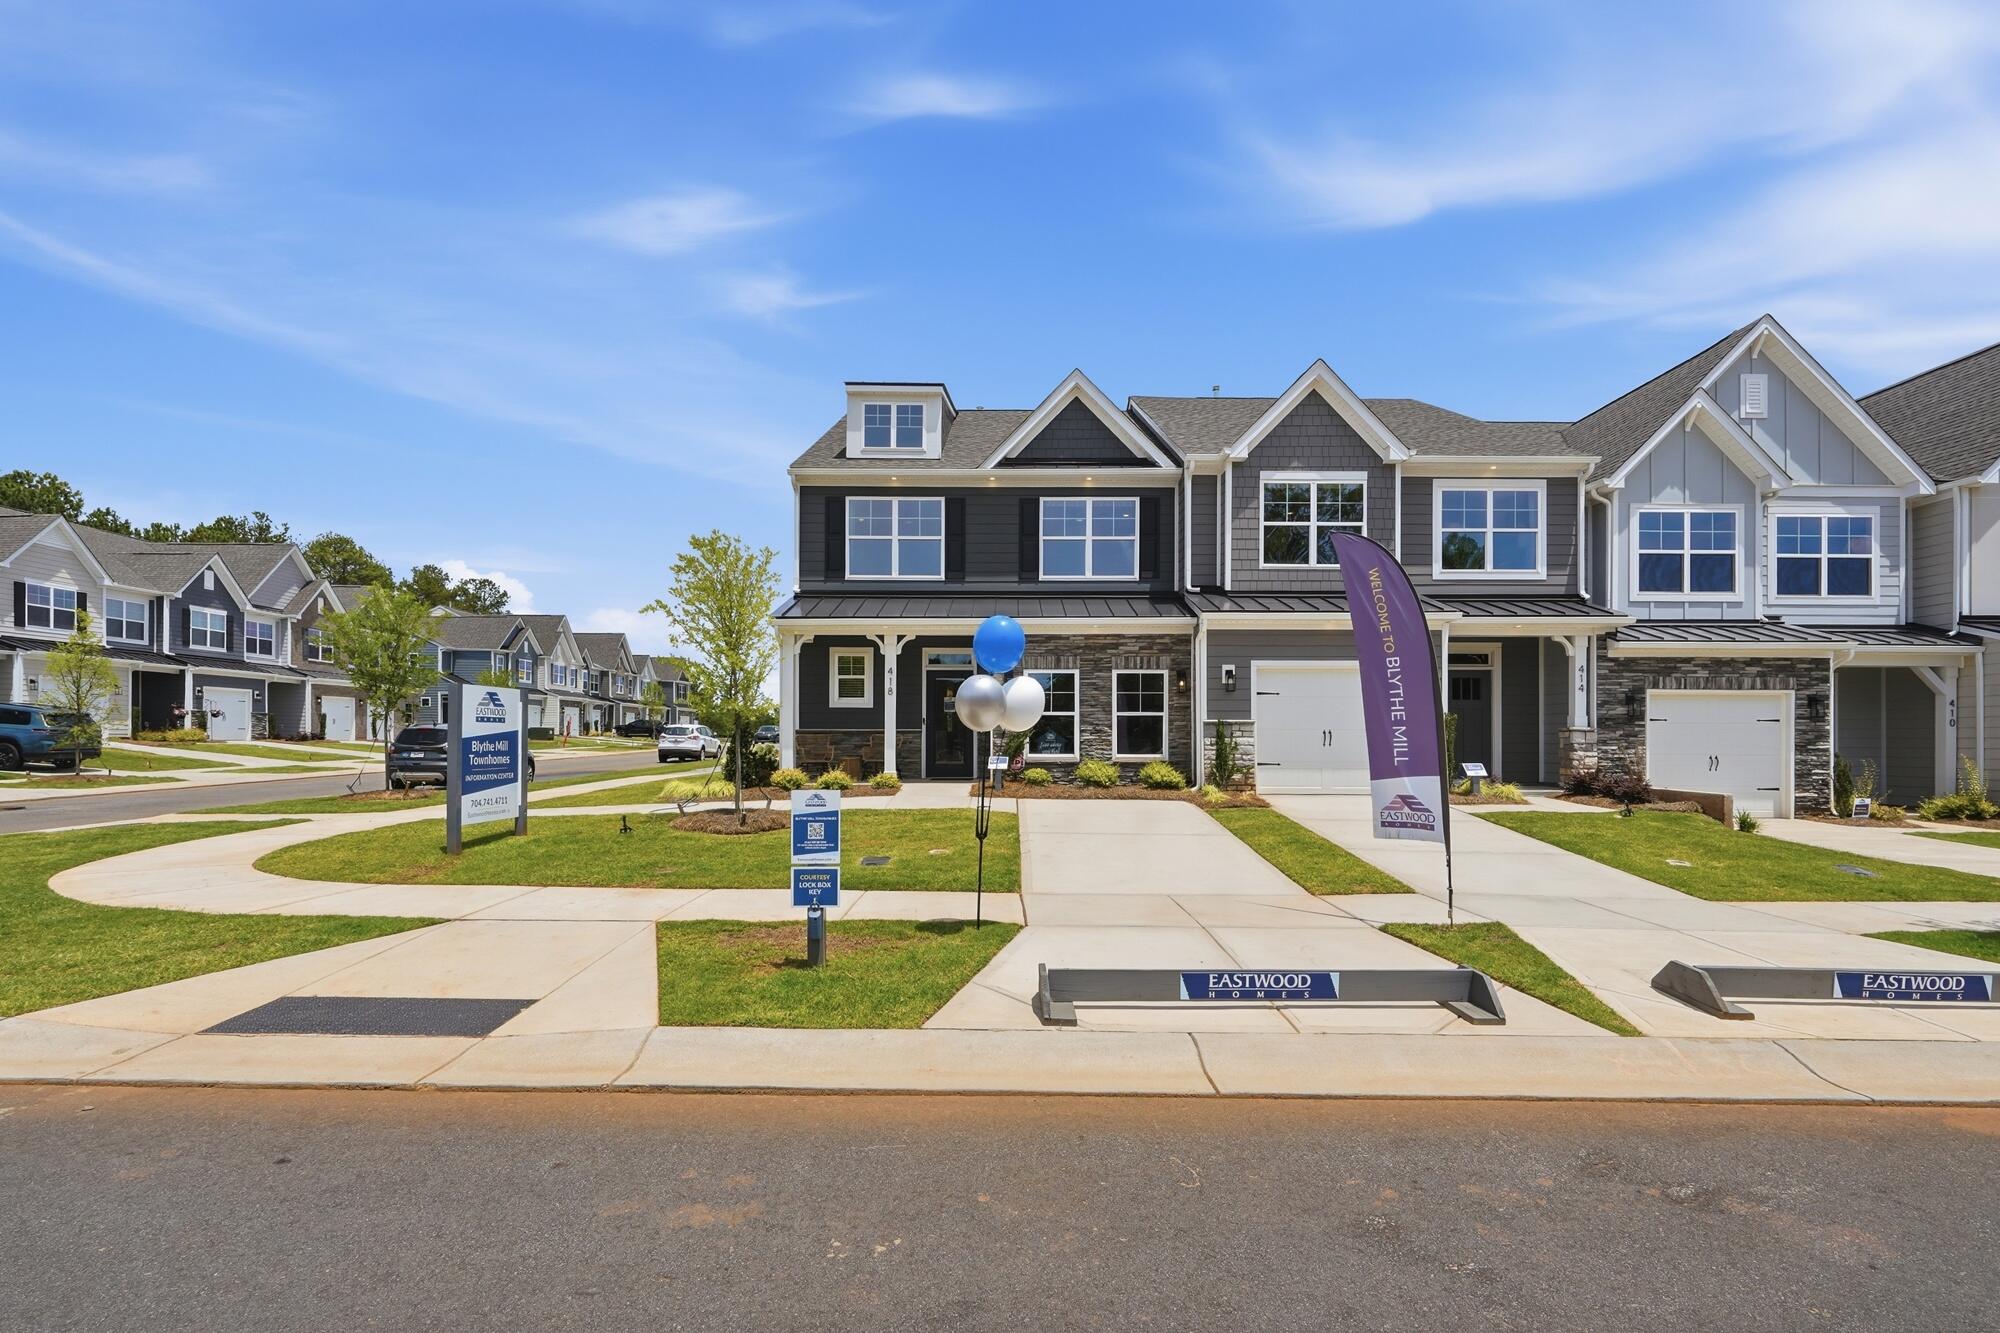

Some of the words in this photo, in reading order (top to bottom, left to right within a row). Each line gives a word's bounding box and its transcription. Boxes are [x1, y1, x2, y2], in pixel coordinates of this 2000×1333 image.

[1368, 567, 1392, 633] WELCOME
[1382, 635, 1395, 653] TO
[1386, 656, 1406, 721] BLYTHE
[476, 707, 507, 717] EASTWOOD
[471, 741, 494, 753] Blythe
[495, 740, 509, 751] Mill
[1392, 726, 1409, 766] MILL
[468, 754, 510, 765] Townhomes
[465, 773, 498, 782] INFORMATION
[1380, 811, 1436, 823] EASTWOOD
[1208, 973, 1311, 988] EASTWOOD
[1863, 974, 1965, 991] EASTWOOD
[1208, 991, 1310, 999] HOMES
[1862, 991, 1963, 1001] HOMES
